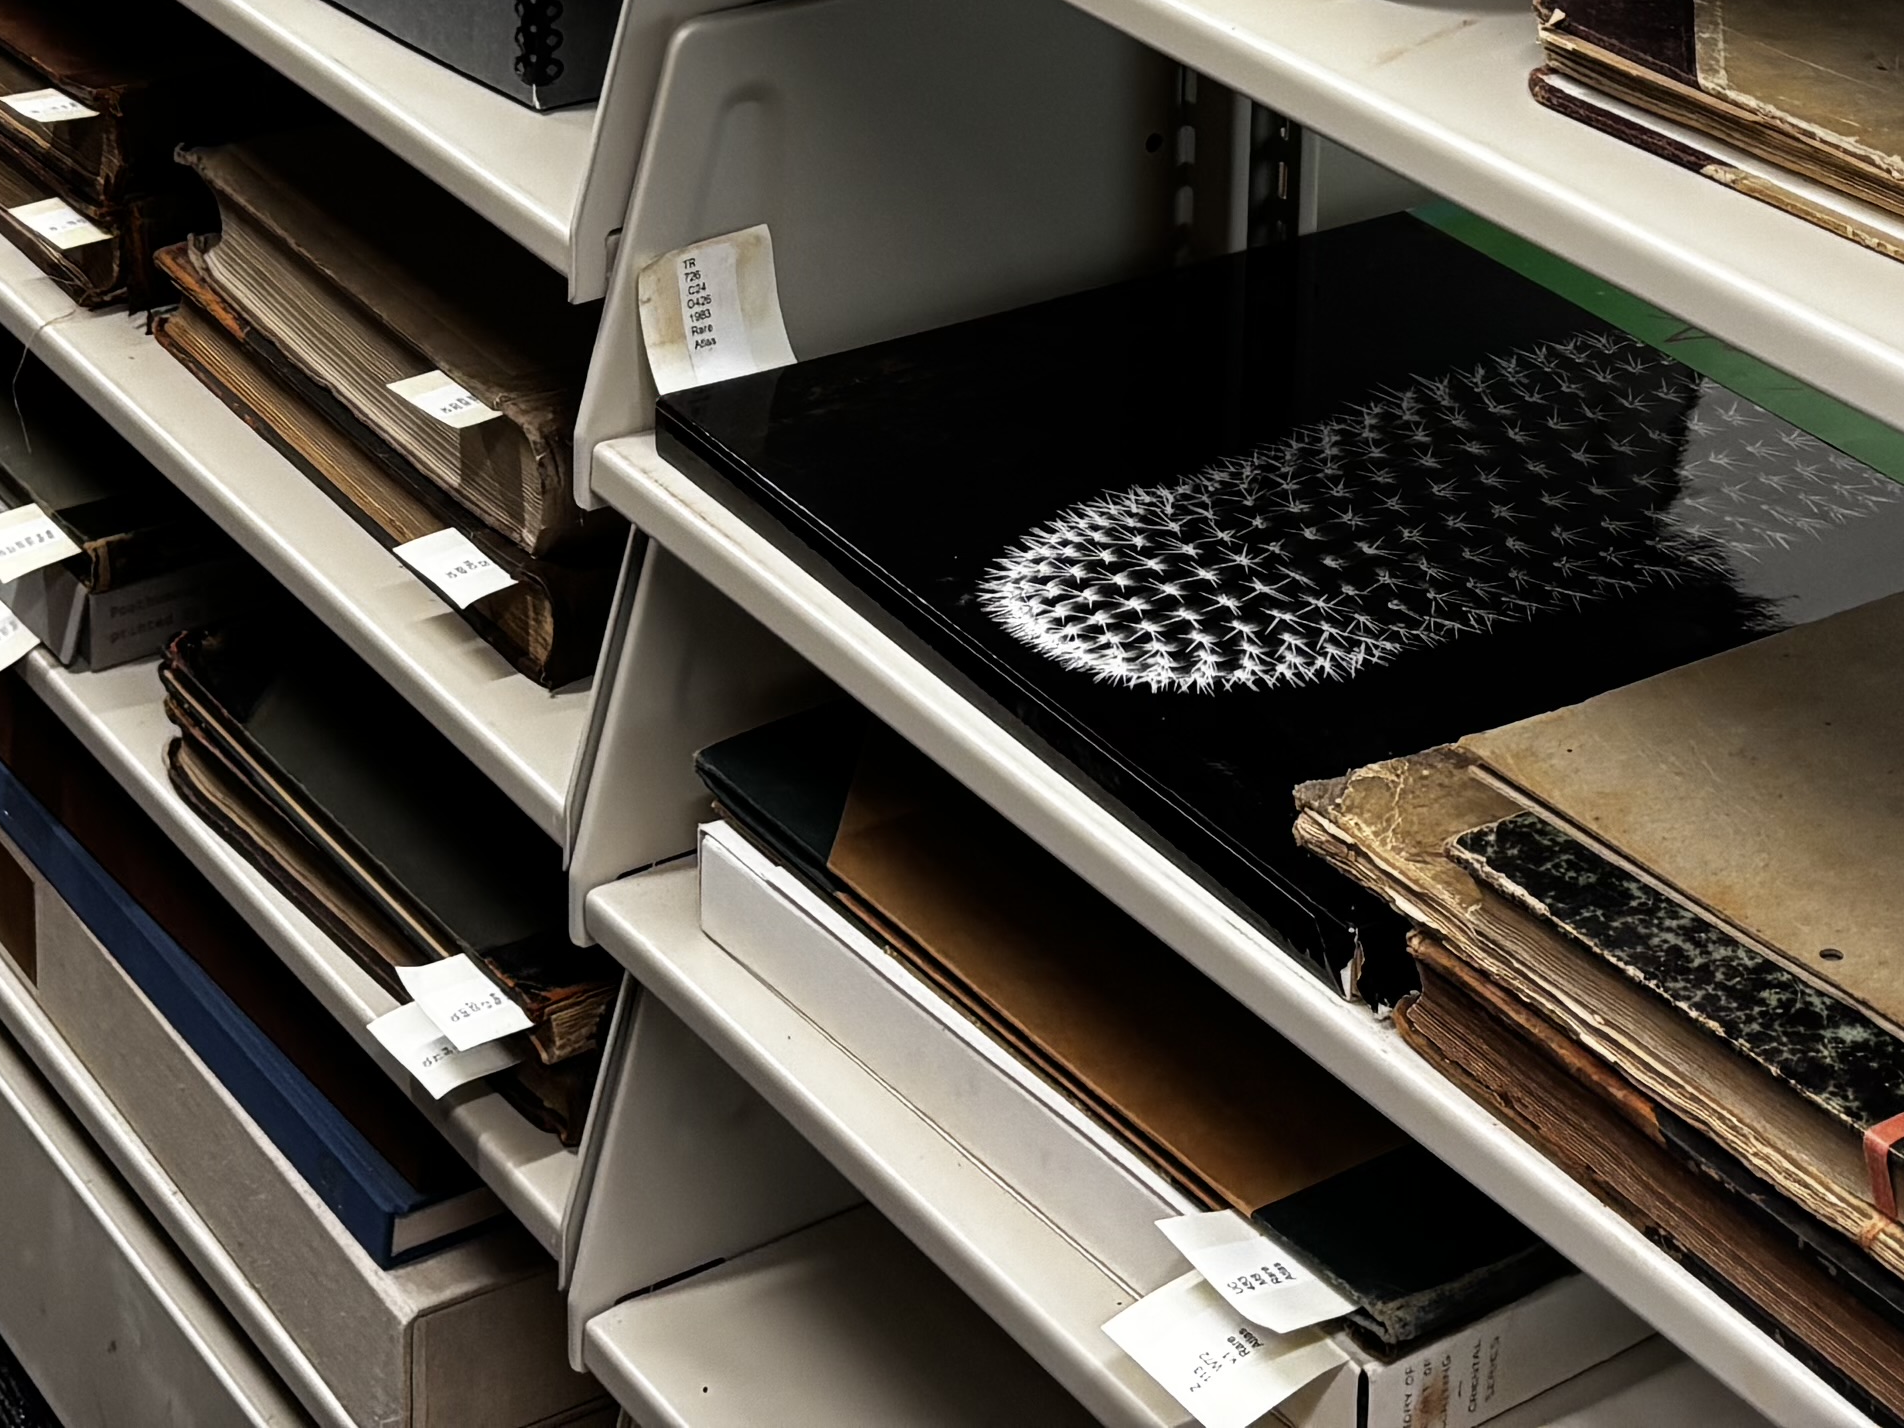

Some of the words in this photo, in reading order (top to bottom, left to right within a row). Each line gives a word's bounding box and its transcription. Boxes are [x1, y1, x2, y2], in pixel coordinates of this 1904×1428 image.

[691, 323, 713, 338] Rare
[1221, 1335, 1253, 1357] Rare
[1234, 1327, 1266, 1350] Atlas
